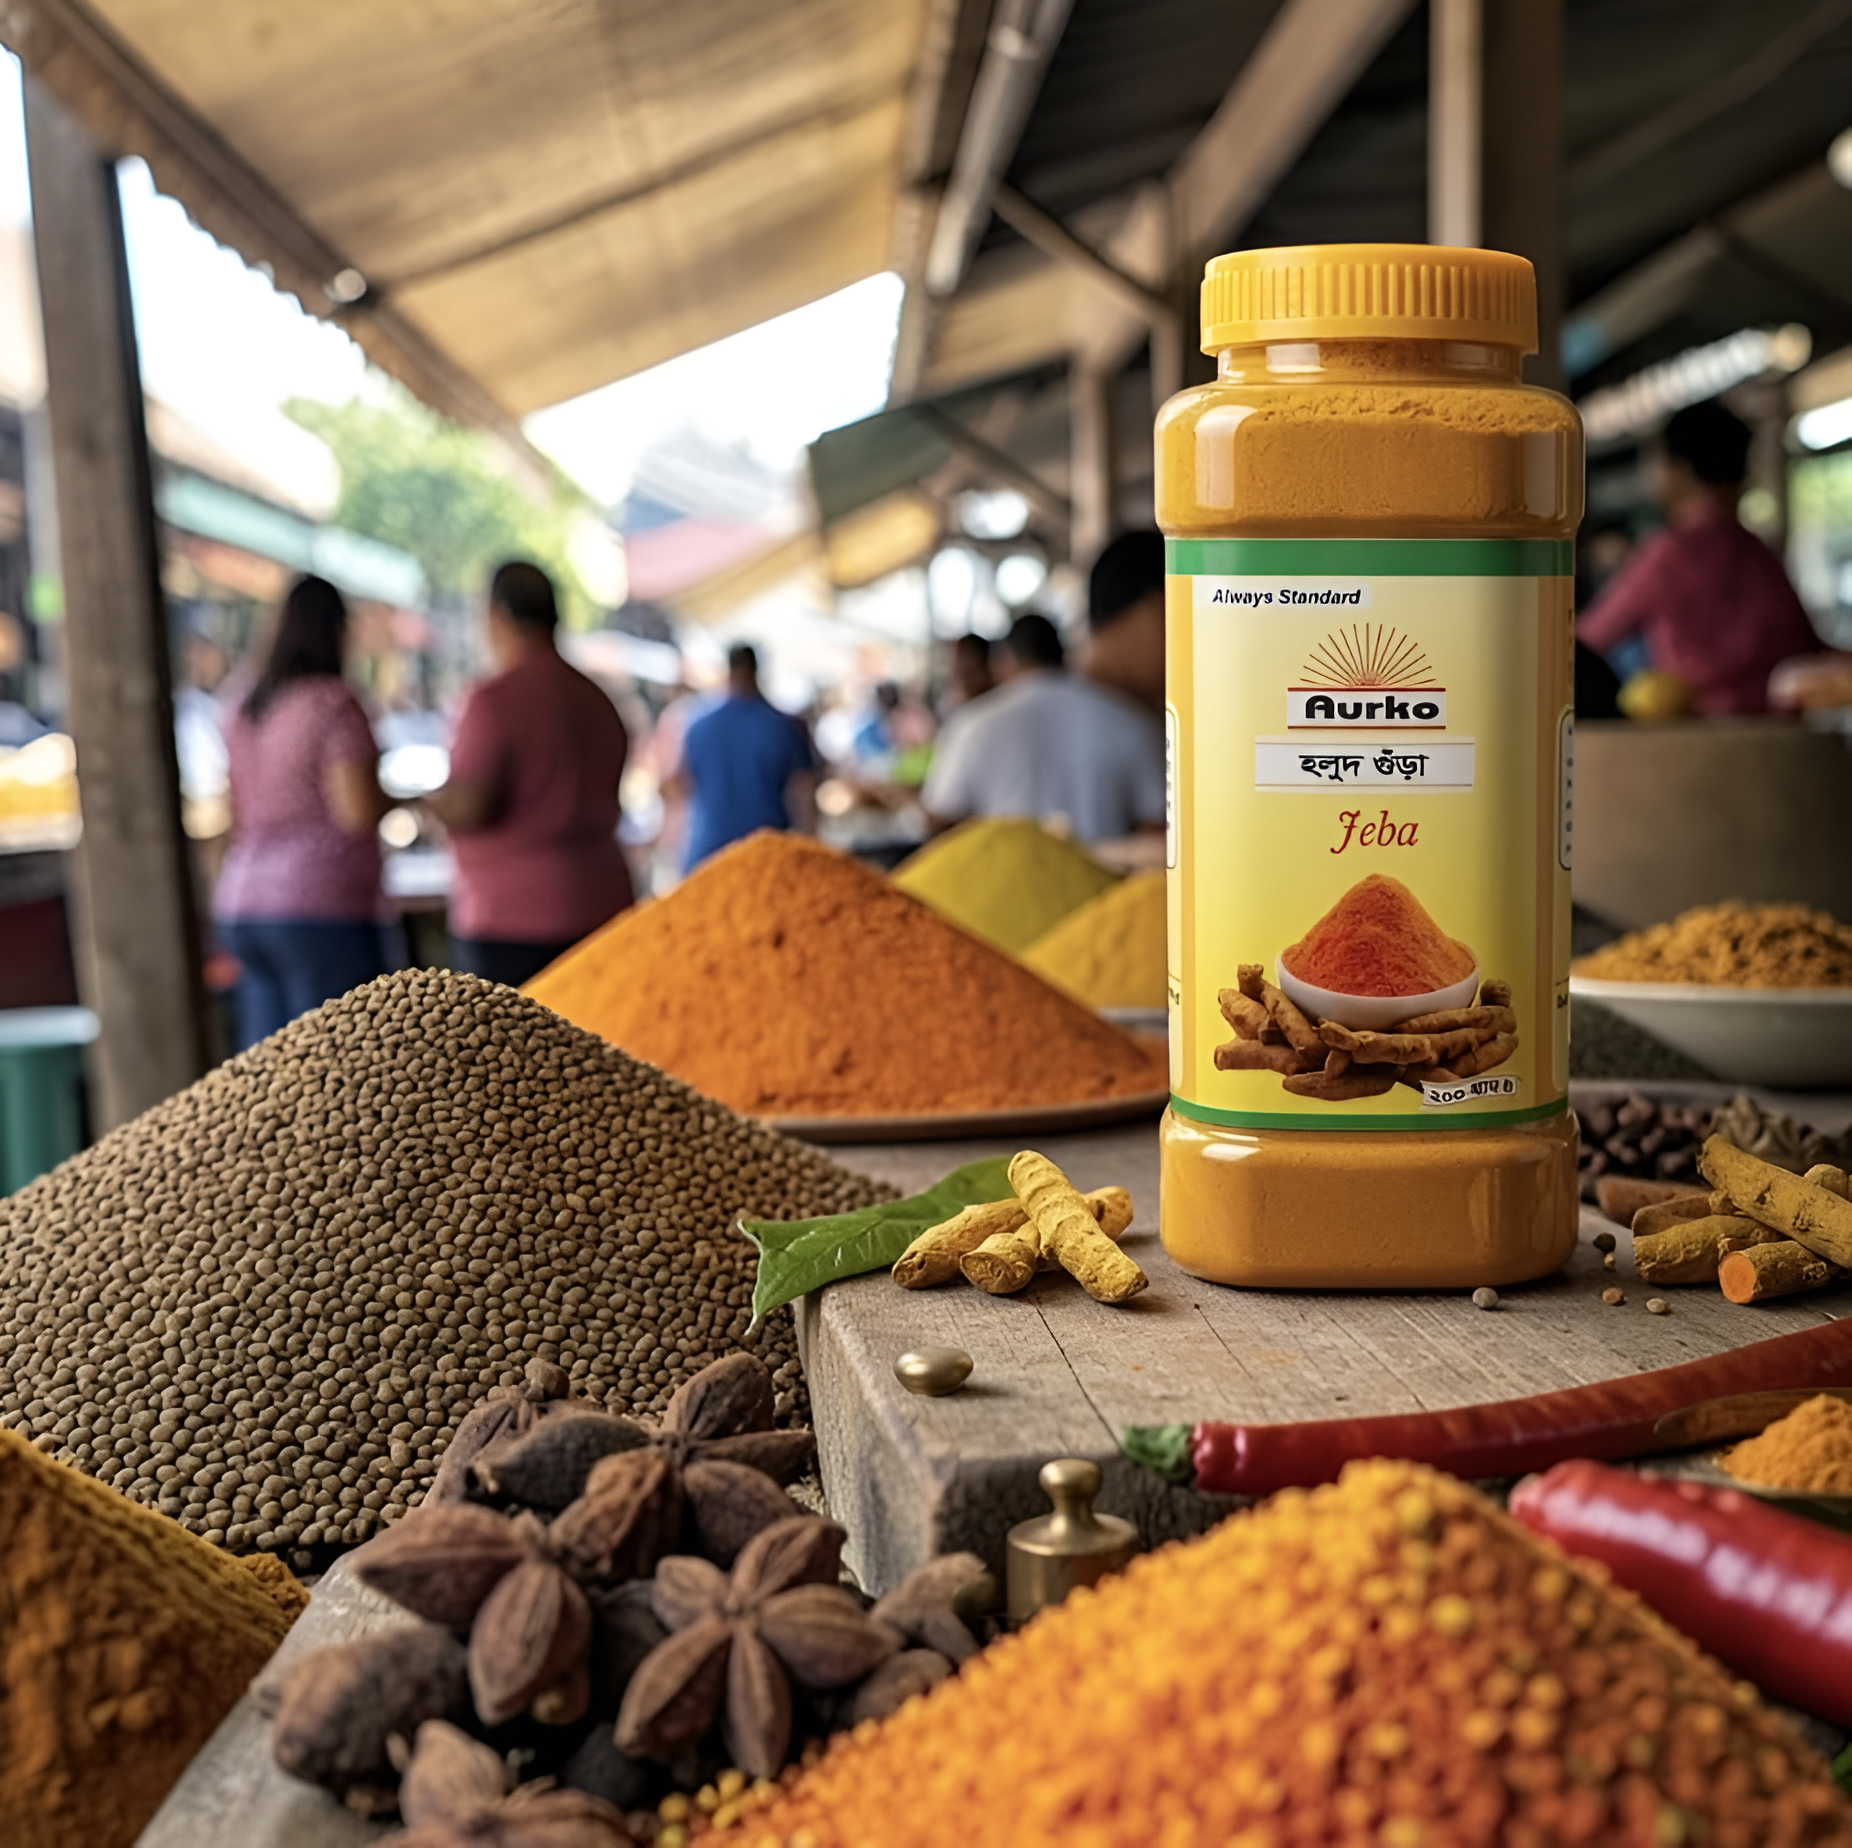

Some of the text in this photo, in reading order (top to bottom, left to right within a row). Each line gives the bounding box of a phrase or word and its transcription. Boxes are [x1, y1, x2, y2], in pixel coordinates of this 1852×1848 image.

[1212, 588, 1361, 608] Always Standard
[1305, 694, 1440, 720] Aurko
[1298, 754, 1365, 782] হলুদ
[1330, 809, 1419, 854] Jeba
